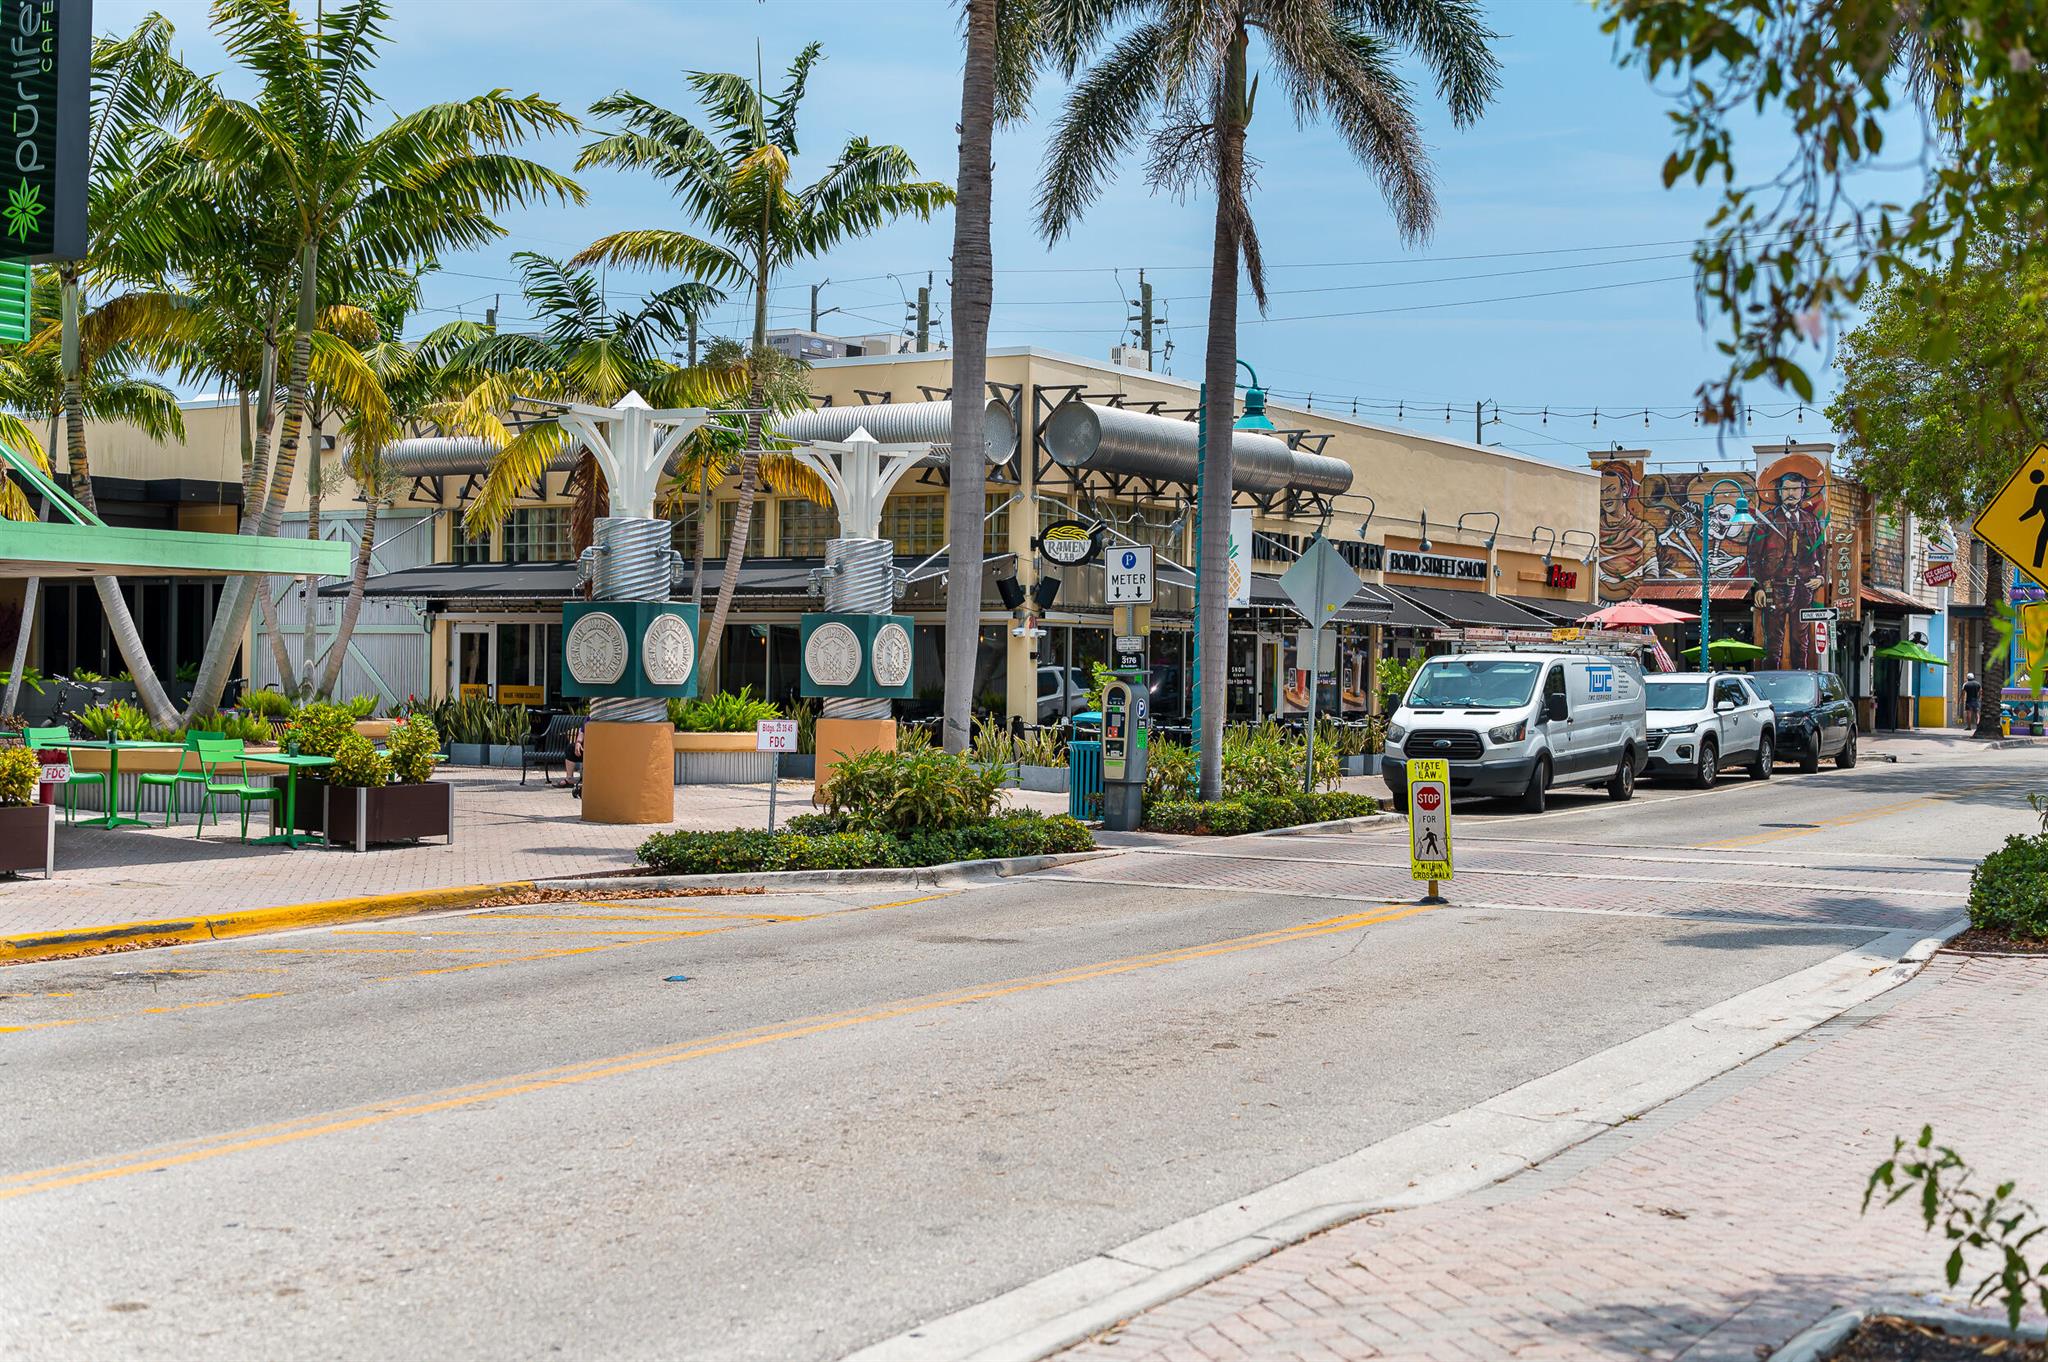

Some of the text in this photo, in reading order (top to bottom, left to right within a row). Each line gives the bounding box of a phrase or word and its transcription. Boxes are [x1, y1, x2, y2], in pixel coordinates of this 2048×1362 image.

[41, 1, 54, 72] CAFE
[1047, 541, 1086, 554] RAMEN
[1059, 553, 1075, 561] LAB
[1126, 555, 1133, 566] P
[1391, 552, 1487, 579] BOND STREET SALON
[1925, 564, 1951, 579] ICE CREAM
[1111, 574, 1147, 586] METER
[608, 631, 624, 676] COMPANY
[1585, 666, 1612, 692] TWC
[1138, 701, 1144, 715] P
[769, 736, 785, 748] FDC
[1414, 761, 1440, 770] STATE
[46, 767, 65, 779] FDC
[1418, 771, 1437, 779] LAW
[1417, 793, 1440, 804] STOP
[1422, 815, 1436, 823] FOR
[1413, 871, 1450, 879] CROSSWALK
